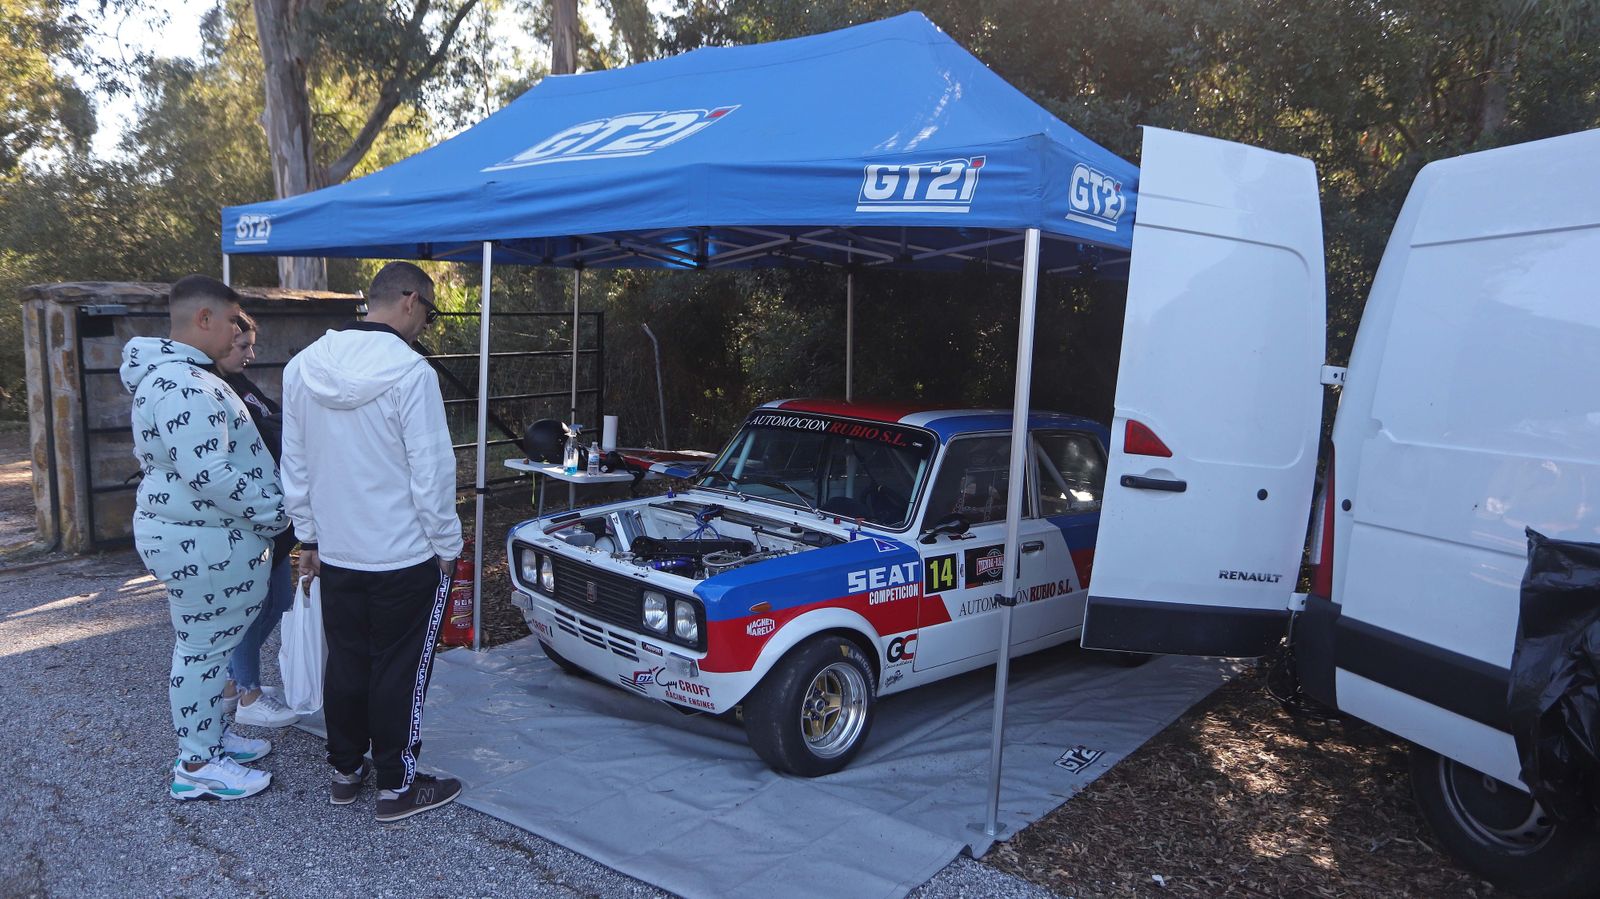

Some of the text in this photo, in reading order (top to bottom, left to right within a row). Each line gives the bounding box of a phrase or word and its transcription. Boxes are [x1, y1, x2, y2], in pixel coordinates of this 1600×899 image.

[152, 377, 178, 392] PXP
[166, 410, 191, 434] PXP
[208, 410, 226, 427] PXP
[751, 415, 831, 432] AUTOMOCION
[828, 421, 880, 440] RUBIO
[193, 438, 219, 459] PXP
[188, 469, 211, 492] PXP
[230, 477, 247, 502] PXP
[148, 492, 170, 505] PXP
[172, 564, 199, 581] PXP
[848, 561, 919, 594] SEAT
[930, 558, 953, 589] 14
[1218, 570, 1282, 584] RENAULT
[223, 580, 254, 598] PXP
[868, 583, 919, 606] COMPETICION
[1030, 582, 1056, 602] RUBIO
[210, 624, 244, 645] PXP
[886, 633, 918, 664] GC
[678, 680, 710, 698] CROFT
[666, 690, 716, 710] RACING ENGINES
[416, 788, 435, 804] N
